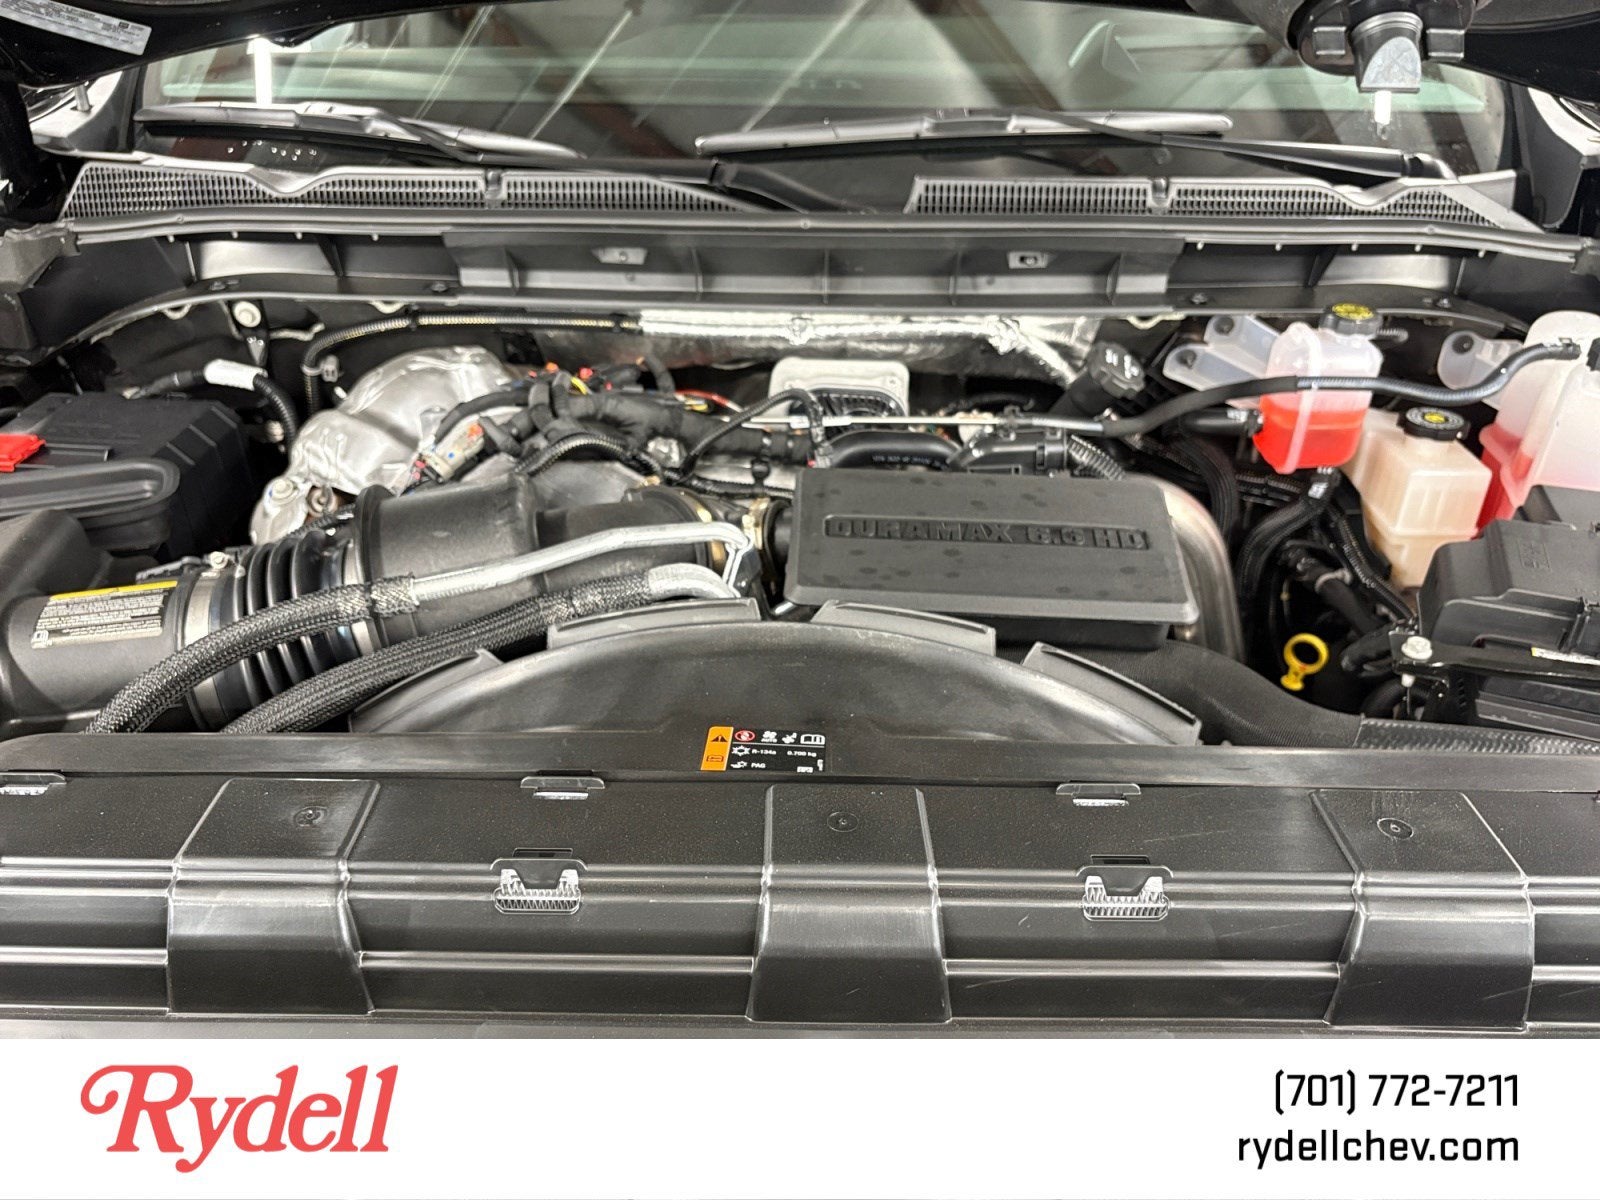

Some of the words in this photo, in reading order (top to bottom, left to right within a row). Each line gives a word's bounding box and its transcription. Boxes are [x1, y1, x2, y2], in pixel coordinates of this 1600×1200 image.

[829, 517, 1014, 543] DURAMAX
[1027, 525, 1085, 546] 6.6
[1094, 528, 1146, 549] HD
